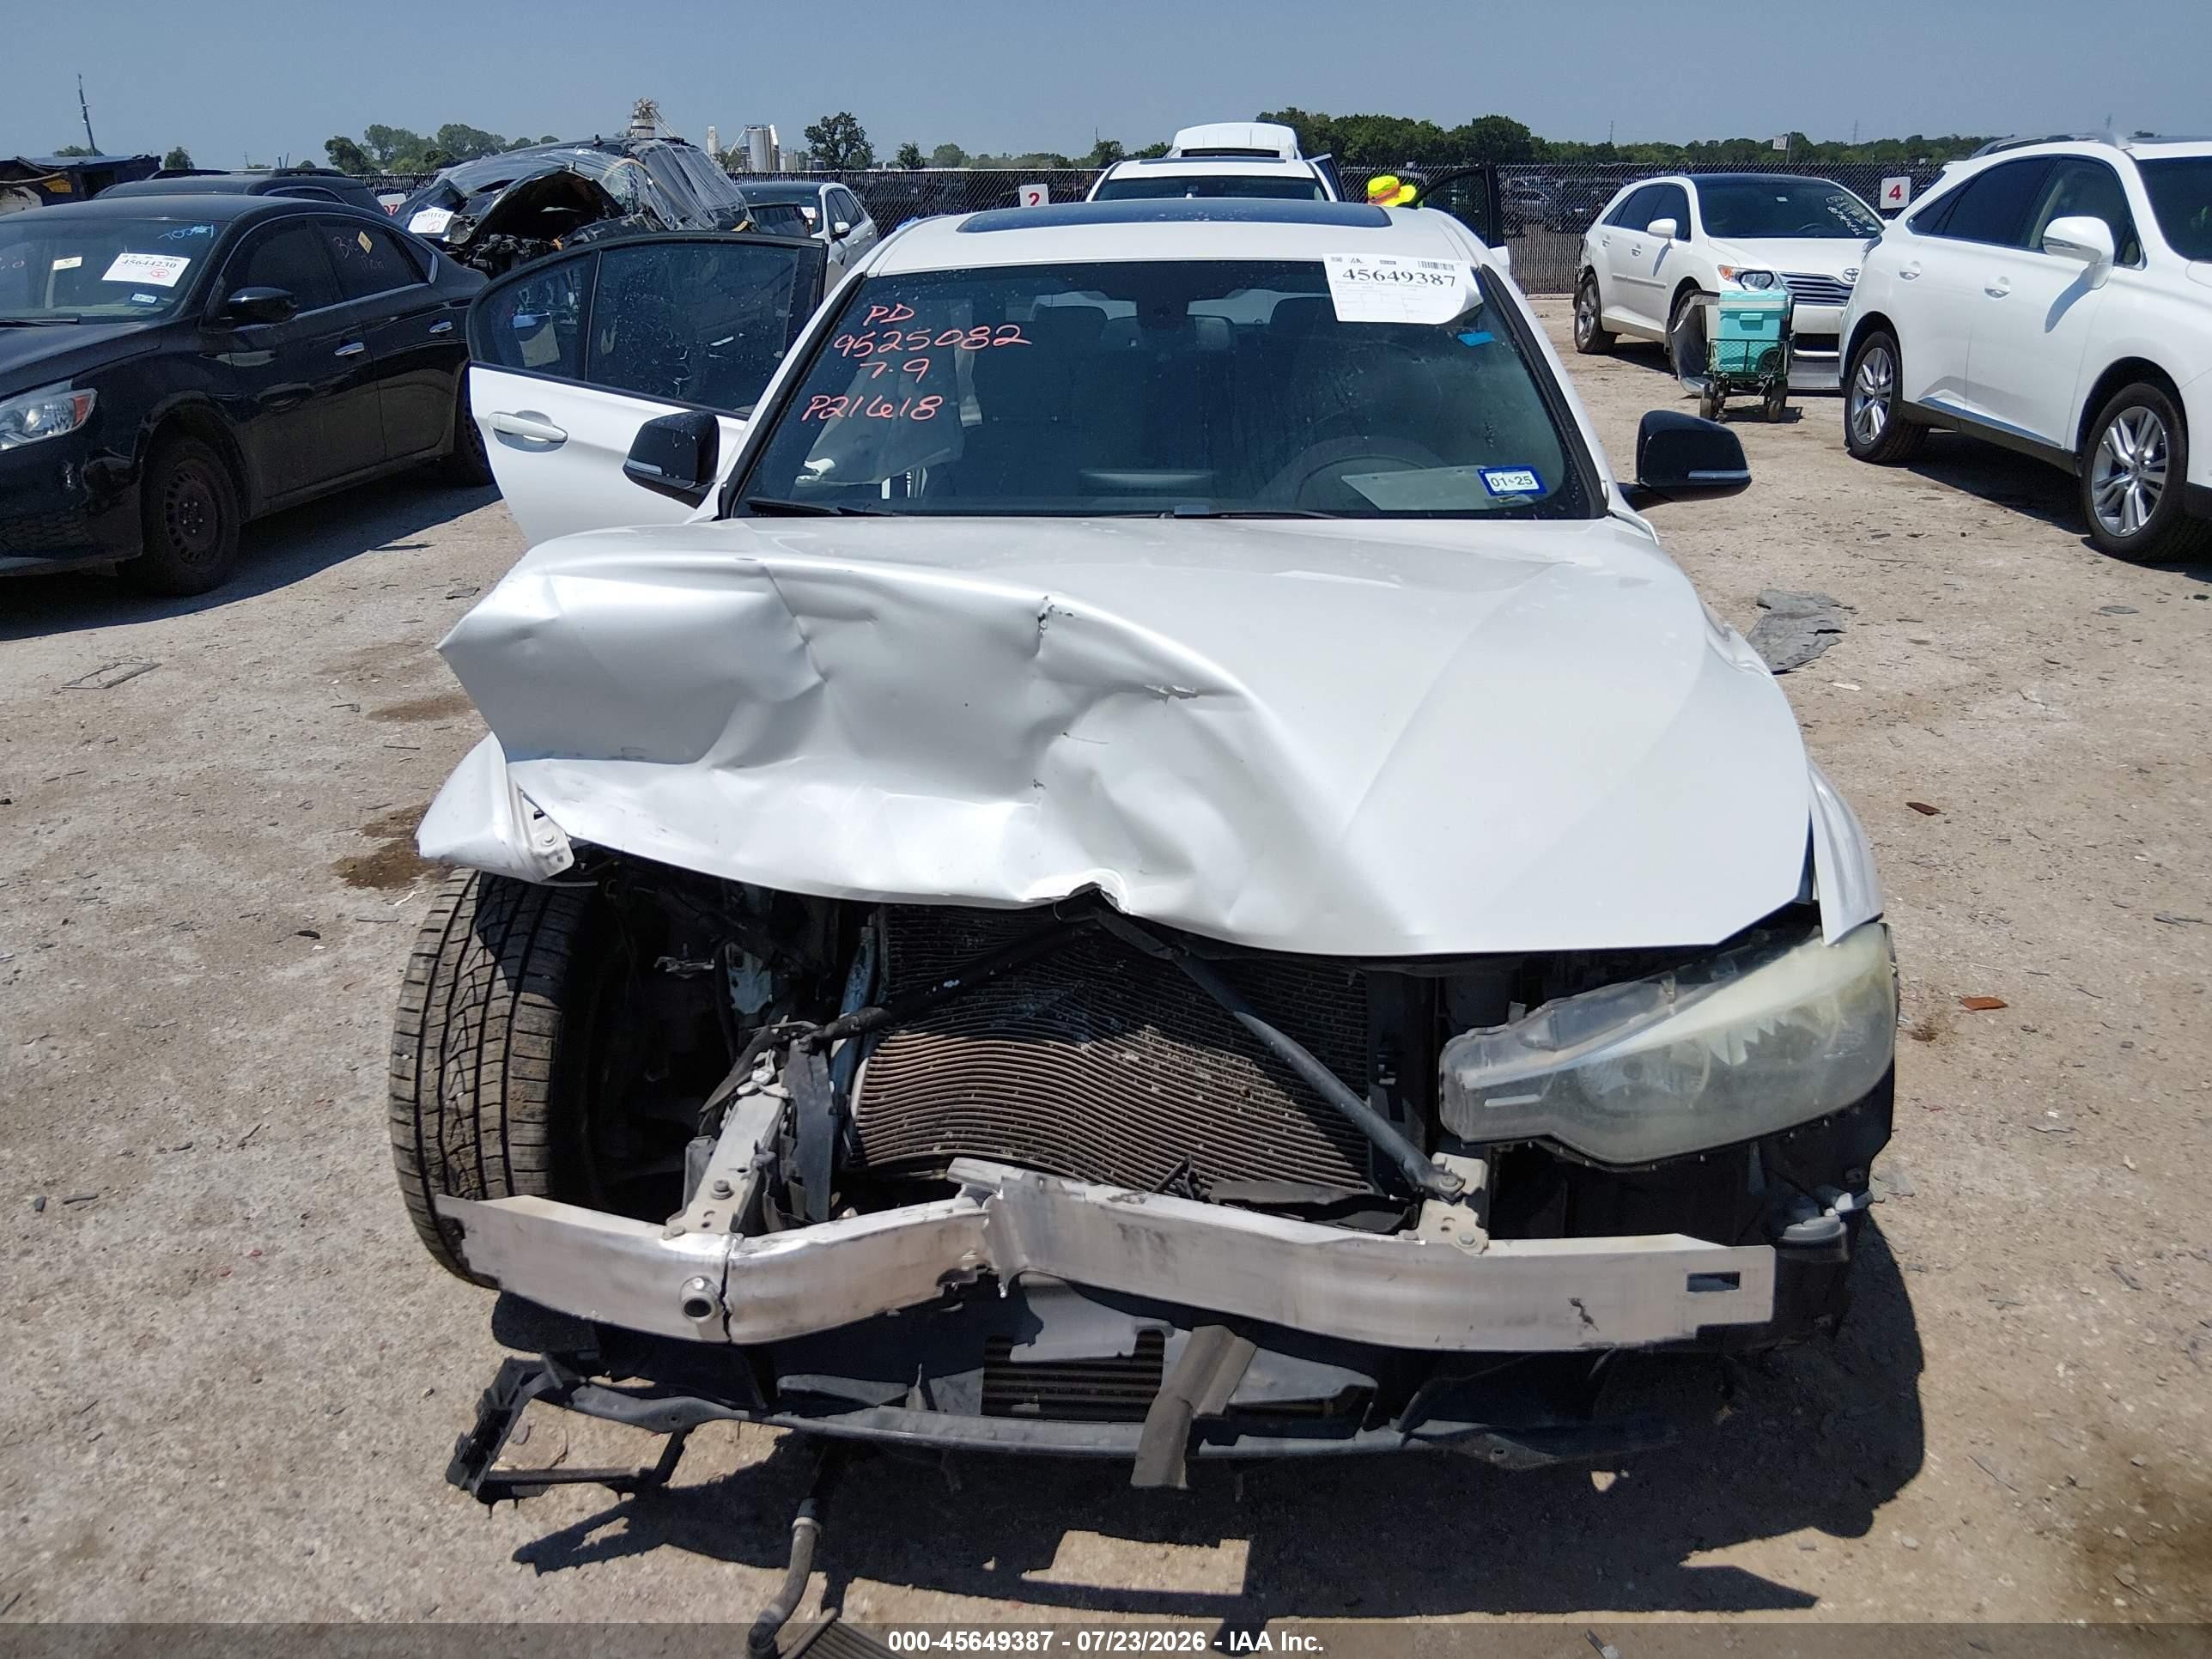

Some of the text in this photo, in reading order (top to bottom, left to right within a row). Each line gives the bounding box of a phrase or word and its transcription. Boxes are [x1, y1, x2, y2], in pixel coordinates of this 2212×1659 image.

[1028, 191, 1041, 207] 2
[1888, 184, 1902, 201] 4
[1342, 268, 1456, 288] 45649387
[862, 303, 915, 326] PD
[833, 324, 1033, 358] 9525082
